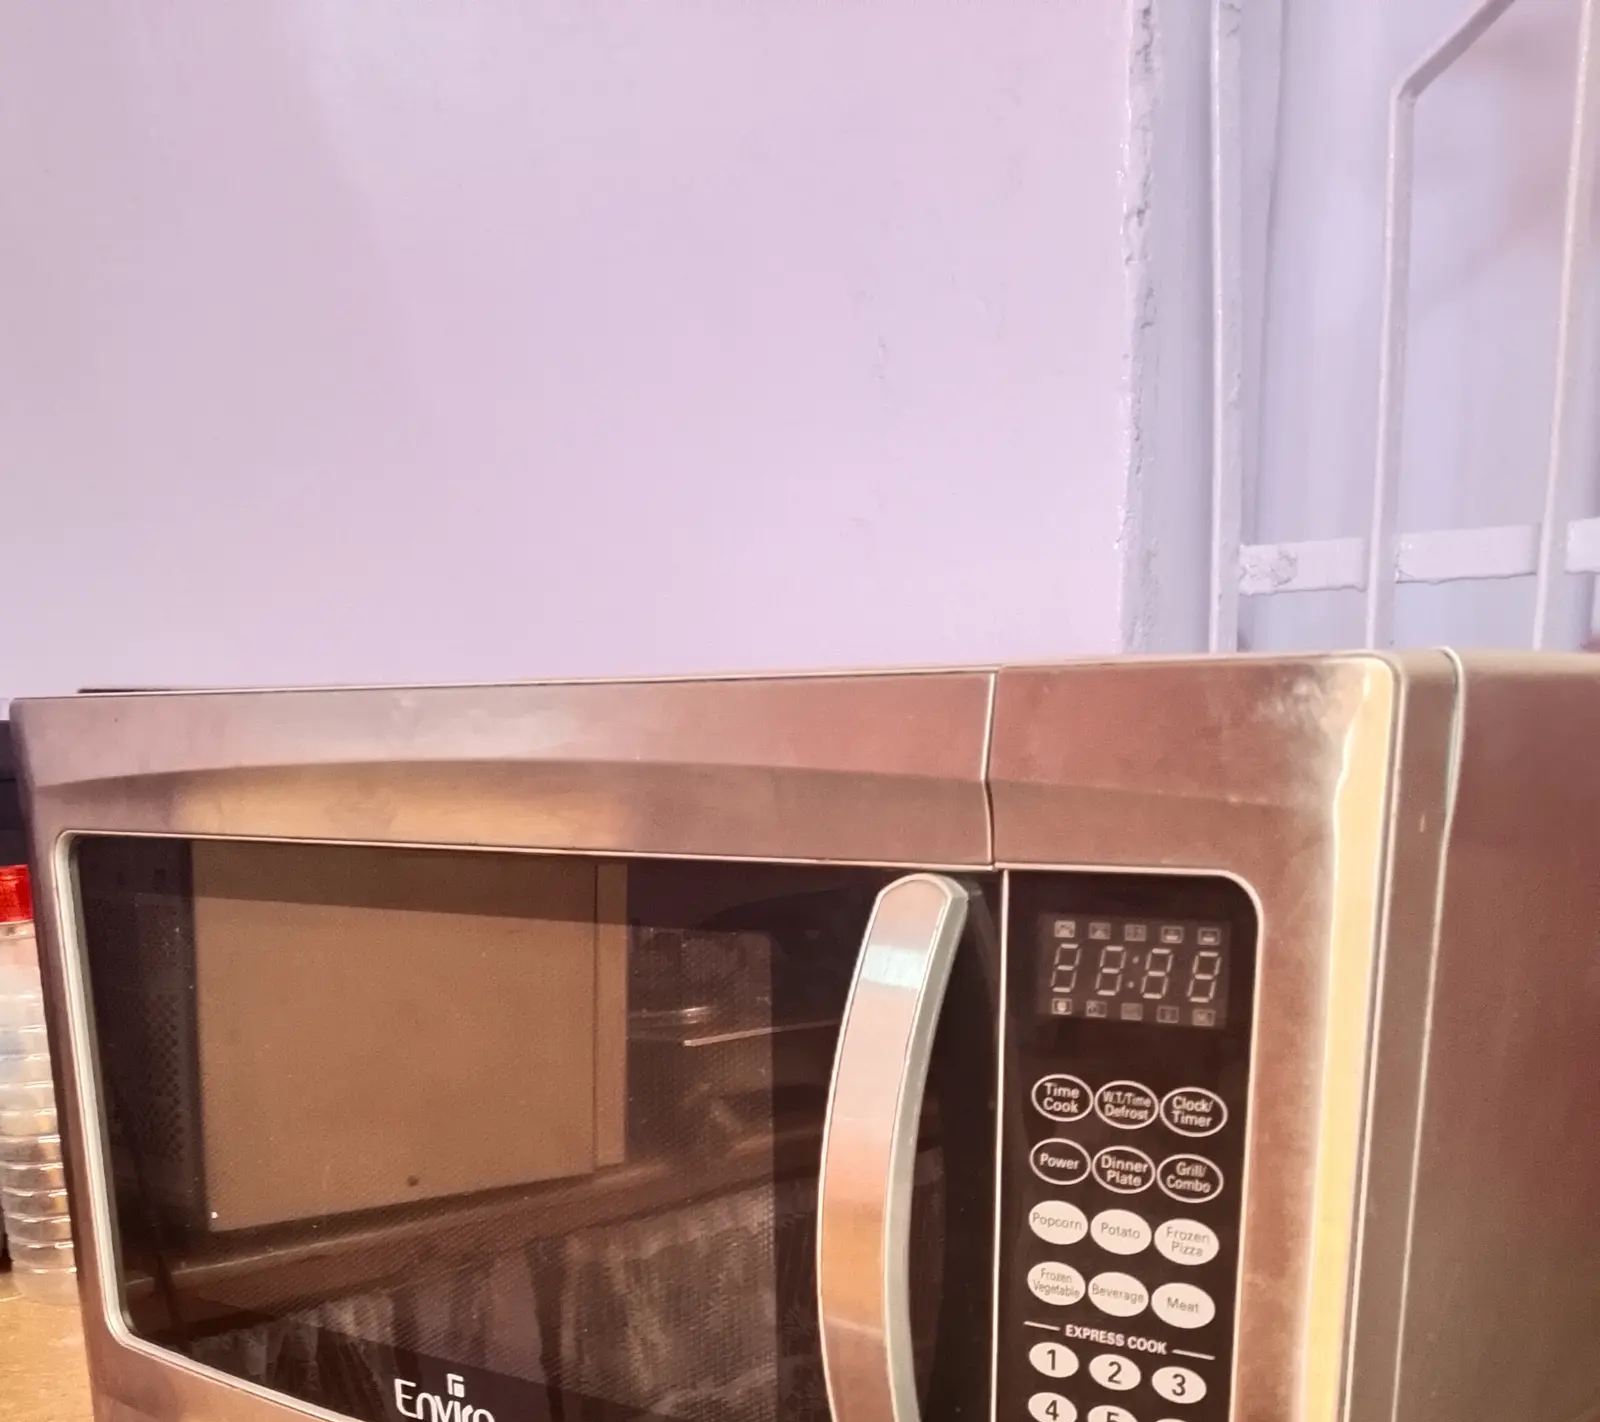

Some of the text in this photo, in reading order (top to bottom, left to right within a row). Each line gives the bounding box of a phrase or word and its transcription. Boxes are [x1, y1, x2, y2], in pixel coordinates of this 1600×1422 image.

[1044, 1082, 1080, 1099] Time
[1043, 1097, 1079, 1113] Cook
[1105, 1104, 1149, 1120] Defrost
[1172, 1096, 1213, 1113] Clock/
[1172, 1111, 1212, 1127] Timer
[1040, 1153, 1080, 1170] Power
[1101, 1154, 1149, 1173] Dinner
[1176, 1161, 1207, 1177] Grill/
[1106, 1169, 1142, 1187] Plate
[1166, 1175, 1211, 1193] Combo
[1032, 1211, 1082, 1230] Popcorn
[1101, 1222, 1140, 1240] Potato
[1166, 1226, 1210, 1244] Frozen
[1171, 1241, 1203, 1257] Pizza
[1040, 1268, 1072, 1283] Frozen
[1033, 1279, 1080, 1298] Vegetable
[1092, 1284, 1144, 1304] Beverage
[1167, 1297, 1199, 1314] Meat
[1064, 1324, 1168, 1355] EXPRESS COOK
[1047, 1349, 1056, 1370] 1
[1108, 1361, 1122, 1384] 2
[1171, 1373, 1186, 1397] 3
[1045, 1400, 1059, 1421] 4
